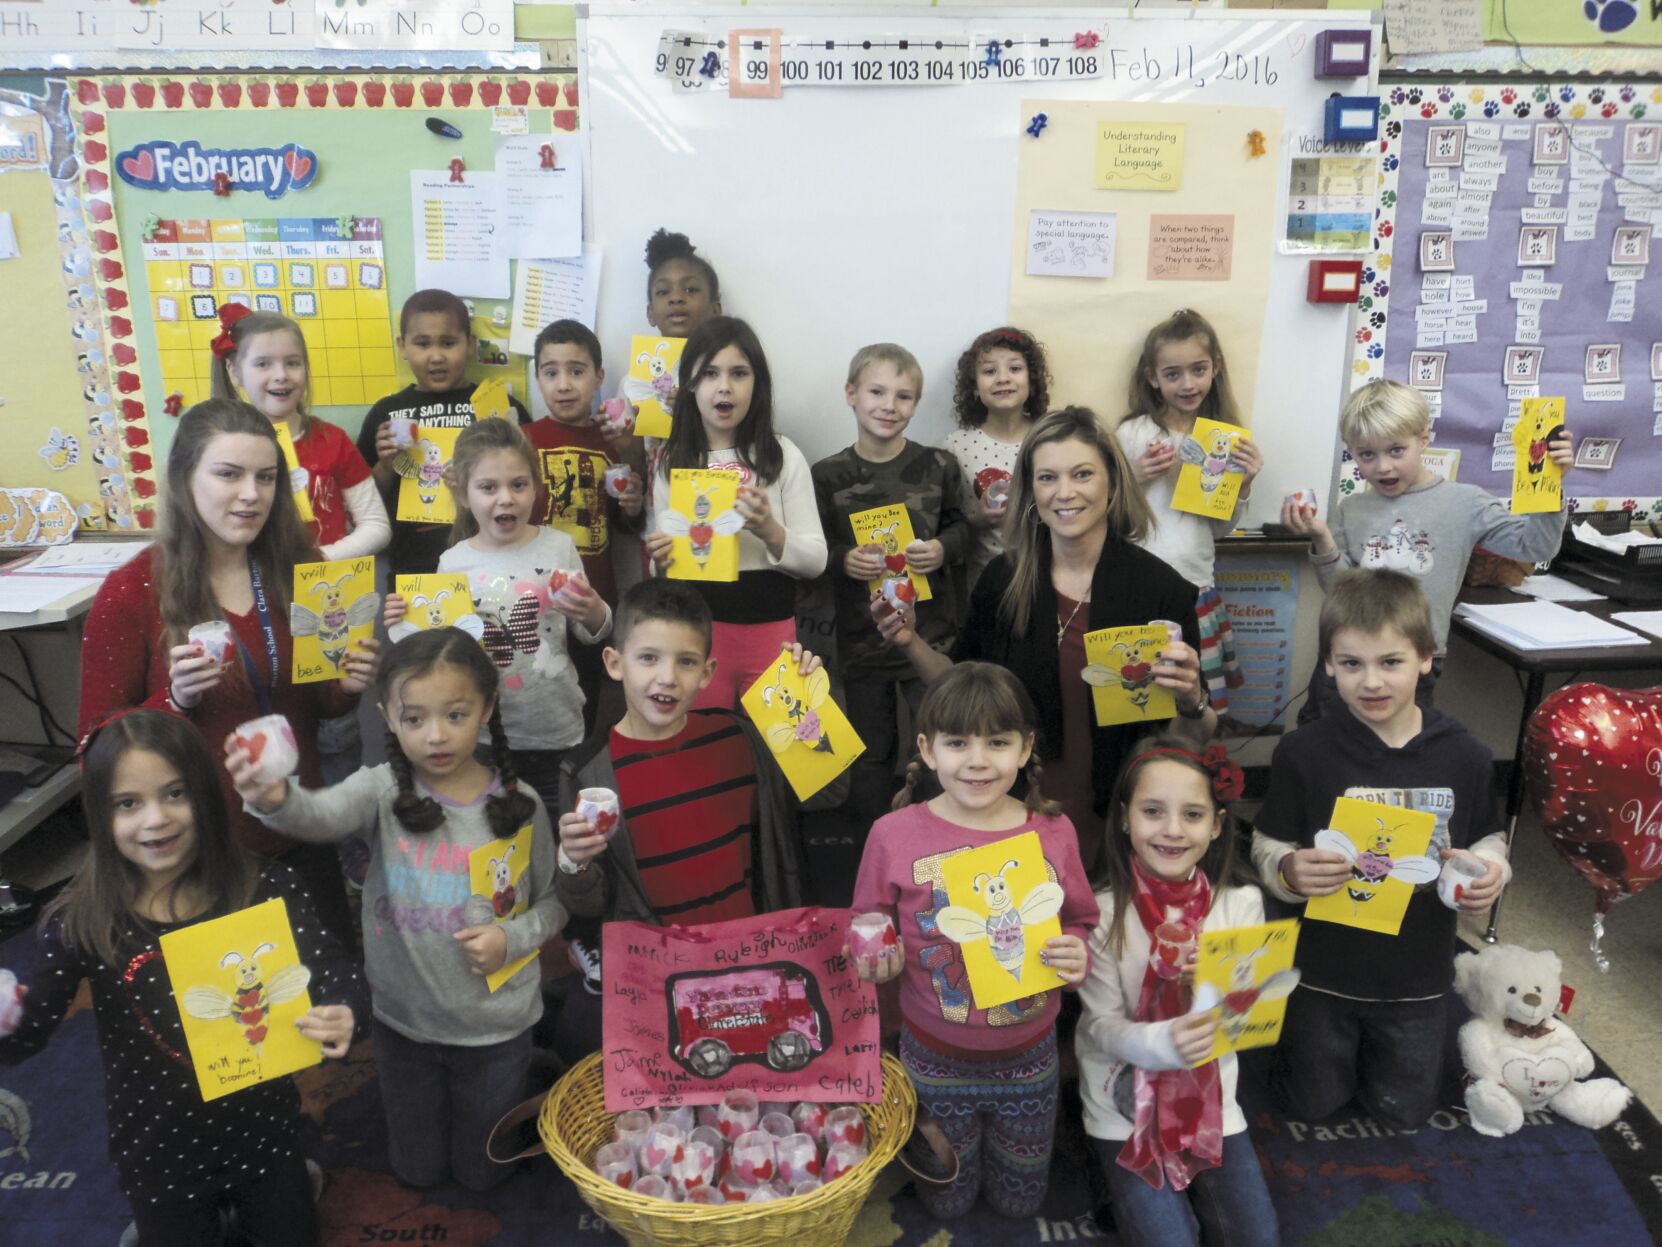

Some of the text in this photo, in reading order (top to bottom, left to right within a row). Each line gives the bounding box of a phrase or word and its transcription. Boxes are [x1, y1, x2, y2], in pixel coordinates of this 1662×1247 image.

[132, 9, 164, 46] Jj
[199, 10, 233, 35] Kk
[323, 11, 374, 35] Mm
[397, 11, 434, 35] Nn
[675, 56, 1097, 80] 97 99 100 101 102 103 104 105 106 107 108
[1110, 48, 1162, 82] Feb
[1214, 47, 1279, 87] 2016
[1473, 127, 1491, 136] also
[1103, 130, 1177, 144] Understanding
[1118, 144, 1160, 156] Literary
[1299, 136, 1330, 154] Voice
[1466, 143, 1498, 152] anyone
[1114, 157, 1163, 170] Language
[1468, 160, 1503, 169] another
[153, 148, 284, 191] February
[1537, 166, 1554, 176] buy
[1463, 177, 1492, 187] always
[1531, 181, 1560, 191] before
[1429, 184, 1455, 193] about
[1460, 191, 1489, 201] almost
[1537, 196, 1549, 206] by
[1428, 200, 1451, 209] again
[1463, 205, 1481, 213] after
[1525, 211, 1565, 220] beautiful
[1038, 218, 1109, 228] Pay attention to
[1035, 229, 1109, 241] special language.
[1160, 225, 1182, 234] When
[1201, 225, 1225, 236] things
[1169, 235, 1208, 246] compared,
[1210, 235, 1230, 243] think
[1170, 245, 1211, 253] about how
[1165, 255, 1192, 266] they're
[1525, 273, 1542, 281] idea
[1611, 268, 1642, 278] journal
[1425, 277, 1447, 286] have
[1425, 291, 1445, 300] hole
[1513, 287, 1558, 296] impossible
[1421, 307, 1454, 316] however
[1462, 304, 1484, 312] house
[1424, 321, 1444, 329] horse
[1455, 319, 1472, 327] hear
[1424, 335, 1441, 343] here
[1452, 332, 1474, 340] heard
[1519, 331, 1537, 340] into
[1510, 388, 1536, 397] pretty
[1585, 389, 1623, 399] question
[388, 407, 415, 423] THEY
[419, 404, 443, 418] SAID
[447, 404, 452, 415] I
[418, 414, 471, 428] ANYTHING
[39, 518, 64, 528] word
[352, 559, 371, 577] you
[255, 589, 267, 612] Clara
[264, 626, 277, 655] School
[297, 663, 323, 679] bee
[1419, 792, 1453, 809] RIDE
[415, 838, 473, 873] I AM
[1523, 1066, 1529, 1080] I
[359, 1223, 448, 1244] South
